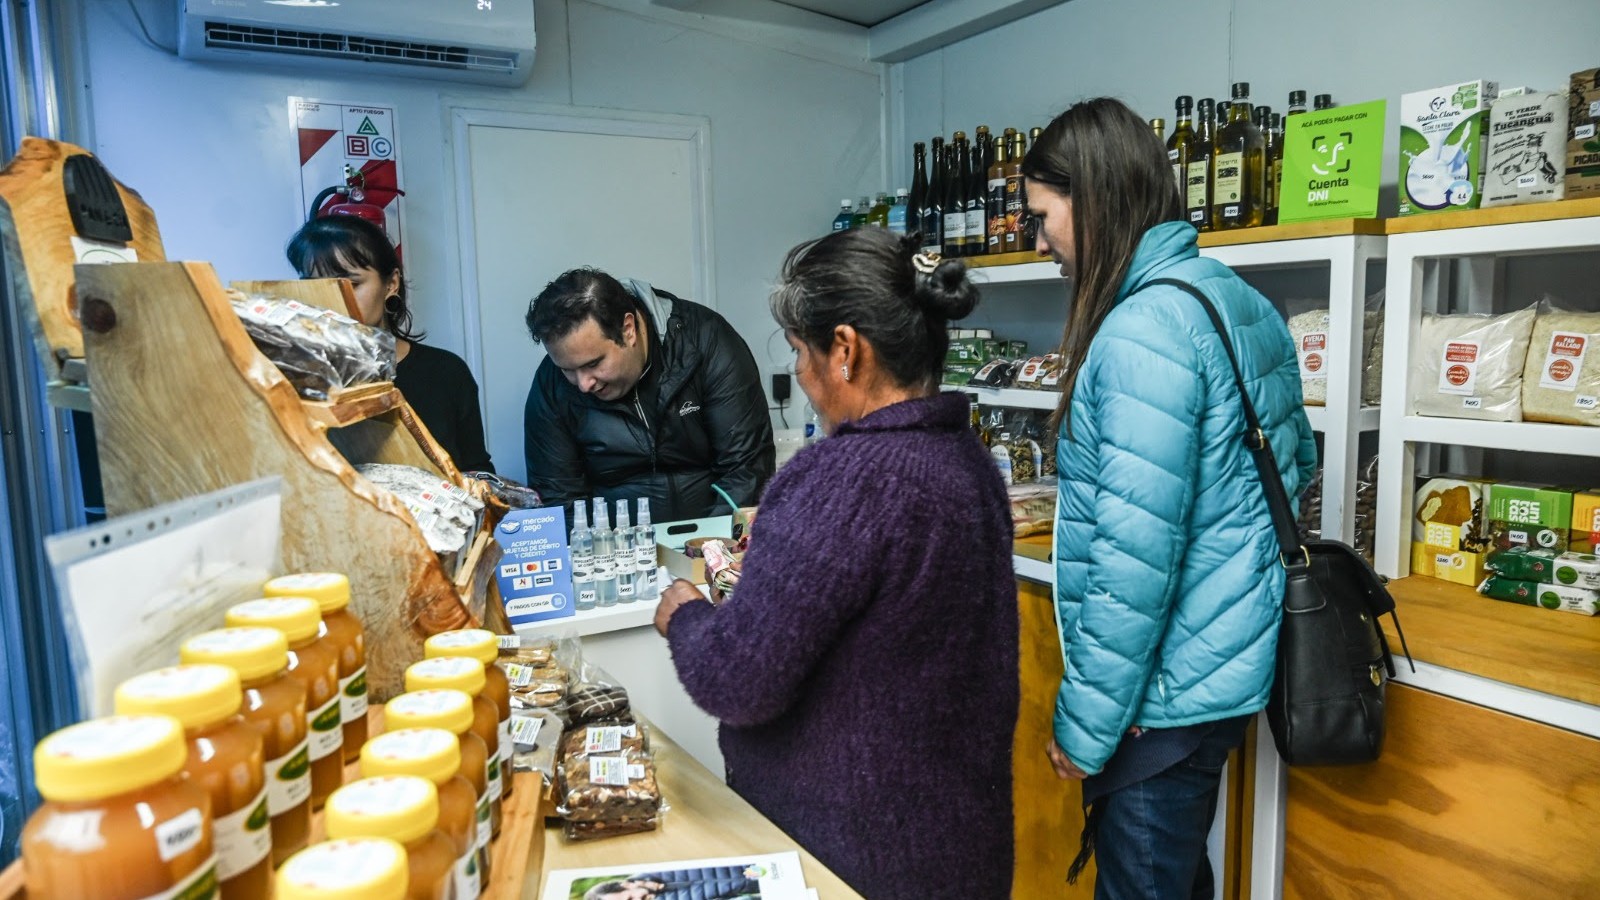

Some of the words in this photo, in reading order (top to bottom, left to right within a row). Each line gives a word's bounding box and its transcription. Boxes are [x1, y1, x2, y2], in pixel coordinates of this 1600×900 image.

[477, 0, 492, 10] 24
[1355, 112, 1368, 120] CON
[1417, 113, 1439, 122] Santa
[1439, 110, 1460, 118] Clara
[1574, 153, 1600, 166] PICAD
[1308, 177, 1349, 190] Cuenta
[1307, 190, 1329, 202] DNI
[1304, 334, 1324, 343] AVENA
[522, 515, 555, 525] mercado
[523, 523, 542, 533] pago
[511, 537, 548, 548] ACEPTAMOS
[503, 547, 529, 555] ARJETAS
[504, 566, 518, 574] VISA
